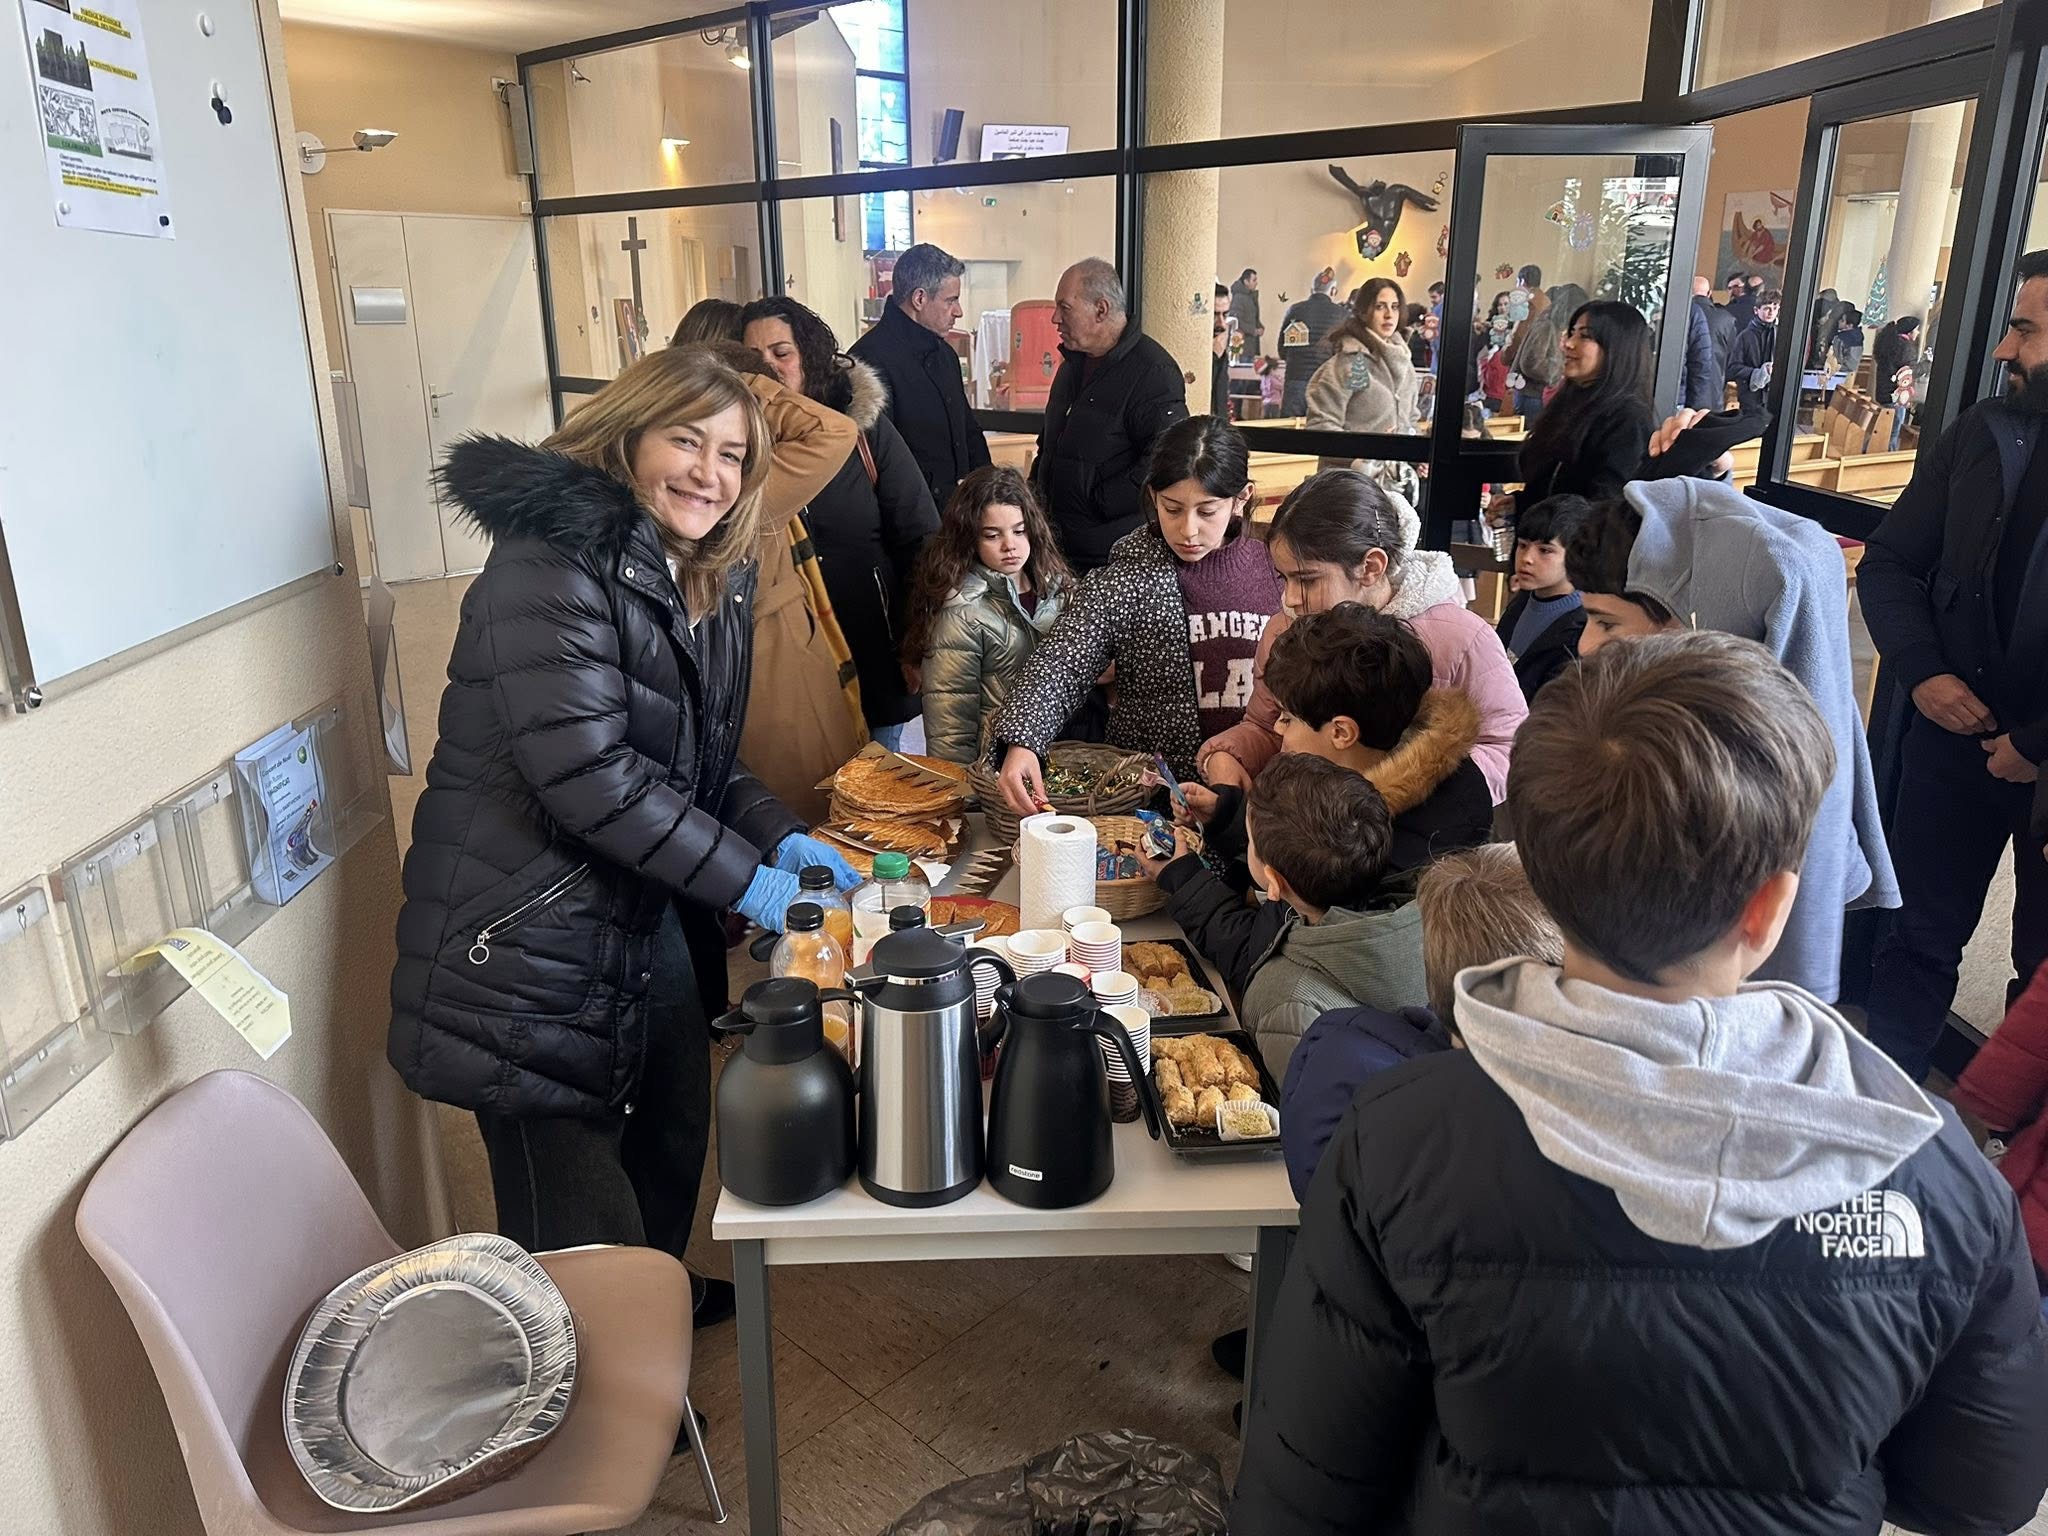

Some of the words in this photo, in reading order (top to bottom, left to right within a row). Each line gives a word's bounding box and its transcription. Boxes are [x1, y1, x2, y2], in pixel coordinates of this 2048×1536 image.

[1193, 658, 1255, 709] LA
[1010, 1167, 1040, 1178] redstone
[1794, 1212, 1882, 1235] NORTH
[1822, 1235, 1882, 1258] FACE
